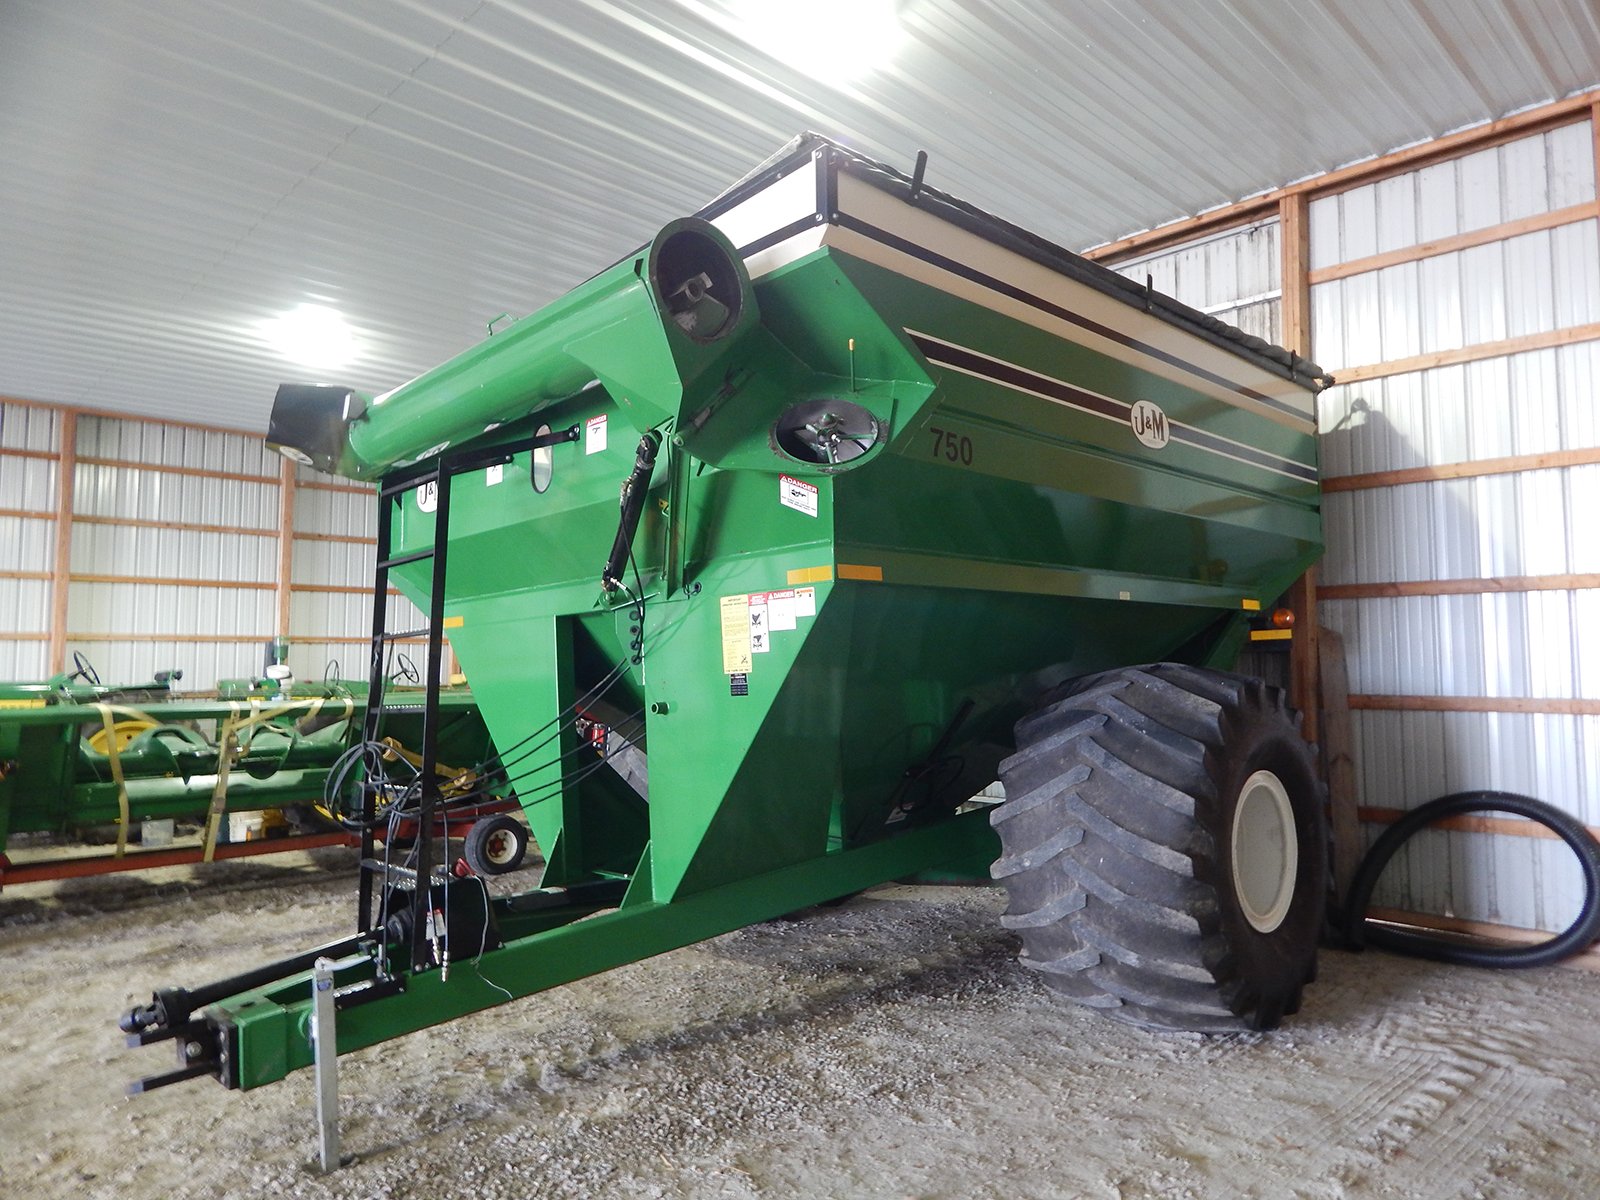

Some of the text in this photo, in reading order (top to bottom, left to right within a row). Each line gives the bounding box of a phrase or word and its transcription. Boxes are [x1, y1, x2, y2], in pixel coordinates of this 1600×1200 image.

[1134, 405, 1166, 442] J&M
[930, 427, 973, 466] 750
[787, 477, 818, 494] DANGER
[774, 590, 795, 600] DANGER
